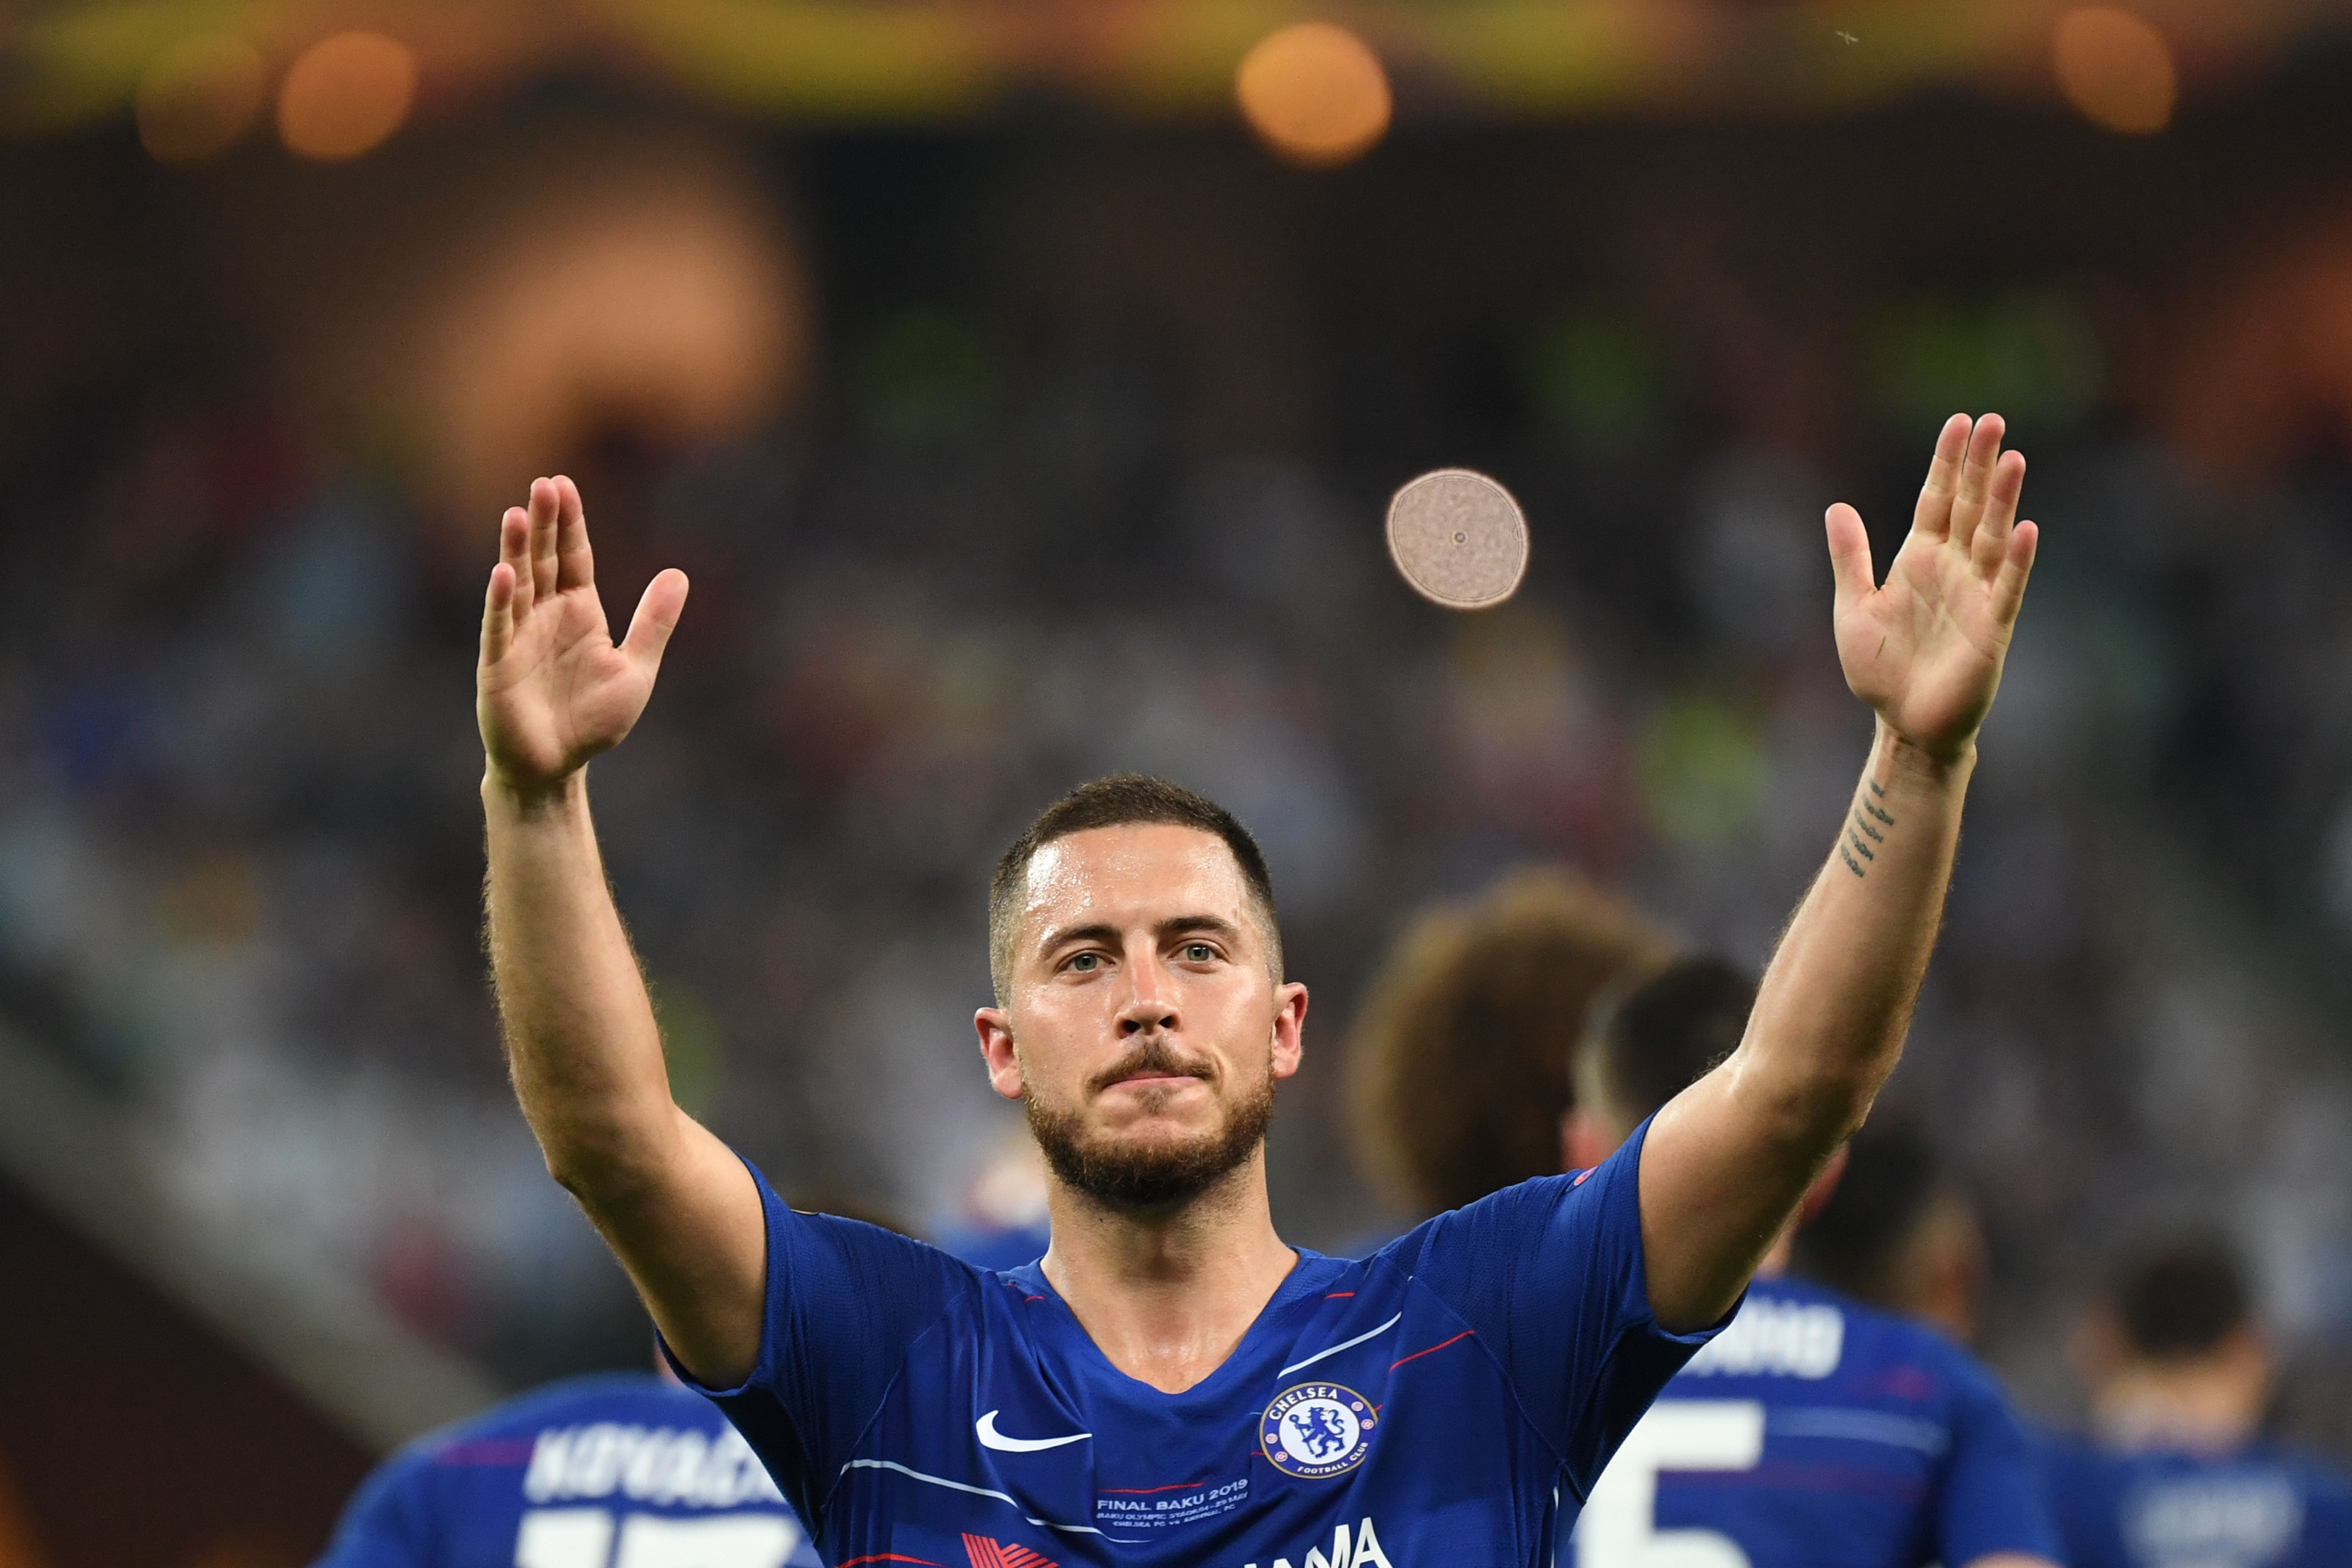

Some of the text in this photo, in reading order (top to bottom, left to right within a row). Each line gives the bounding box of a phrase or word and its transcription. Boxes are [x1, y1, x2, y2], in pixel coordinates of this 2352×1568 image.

[1269, 1387, 1337, 1420] CHELSEA
[1297, 1442, 1368, 1474] FOOTBALL CLUB
[1097, 1479, 1248, 1511] FINAL BAKU 2019
